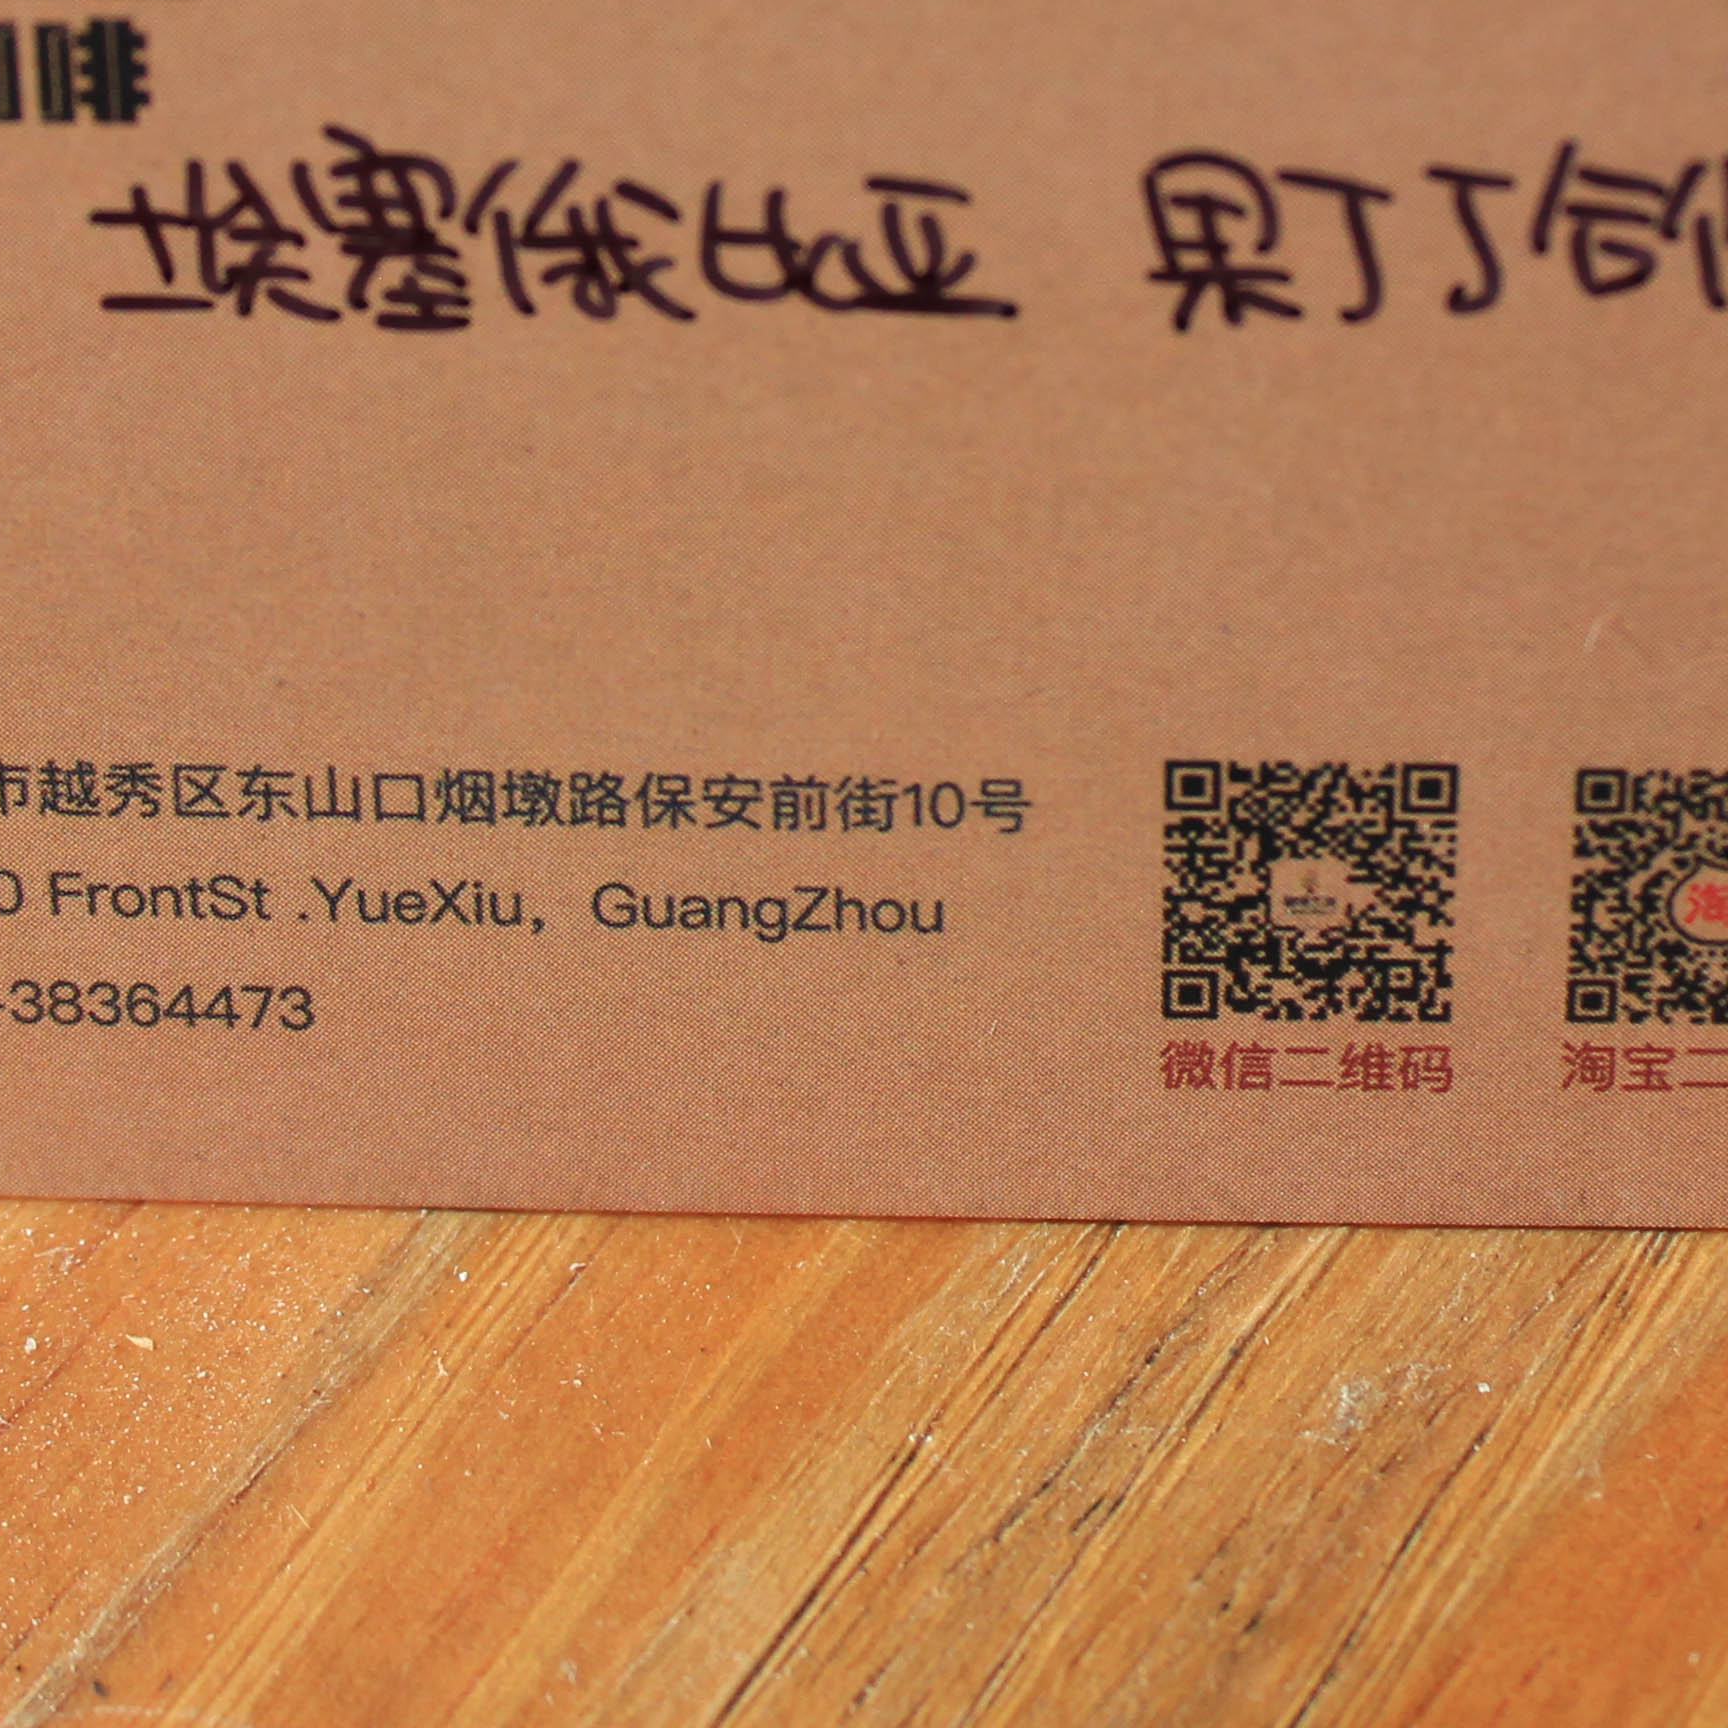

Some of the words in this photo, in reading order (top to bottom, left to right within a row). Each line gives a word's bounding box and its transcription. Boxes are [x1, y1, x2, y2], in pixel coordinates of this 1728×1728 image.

[49, 872, 273, 921] FrontSt
[590, 883, 947, 944] GuangZhou
[1160, 1039, 1454, 1094] 微信二维码
